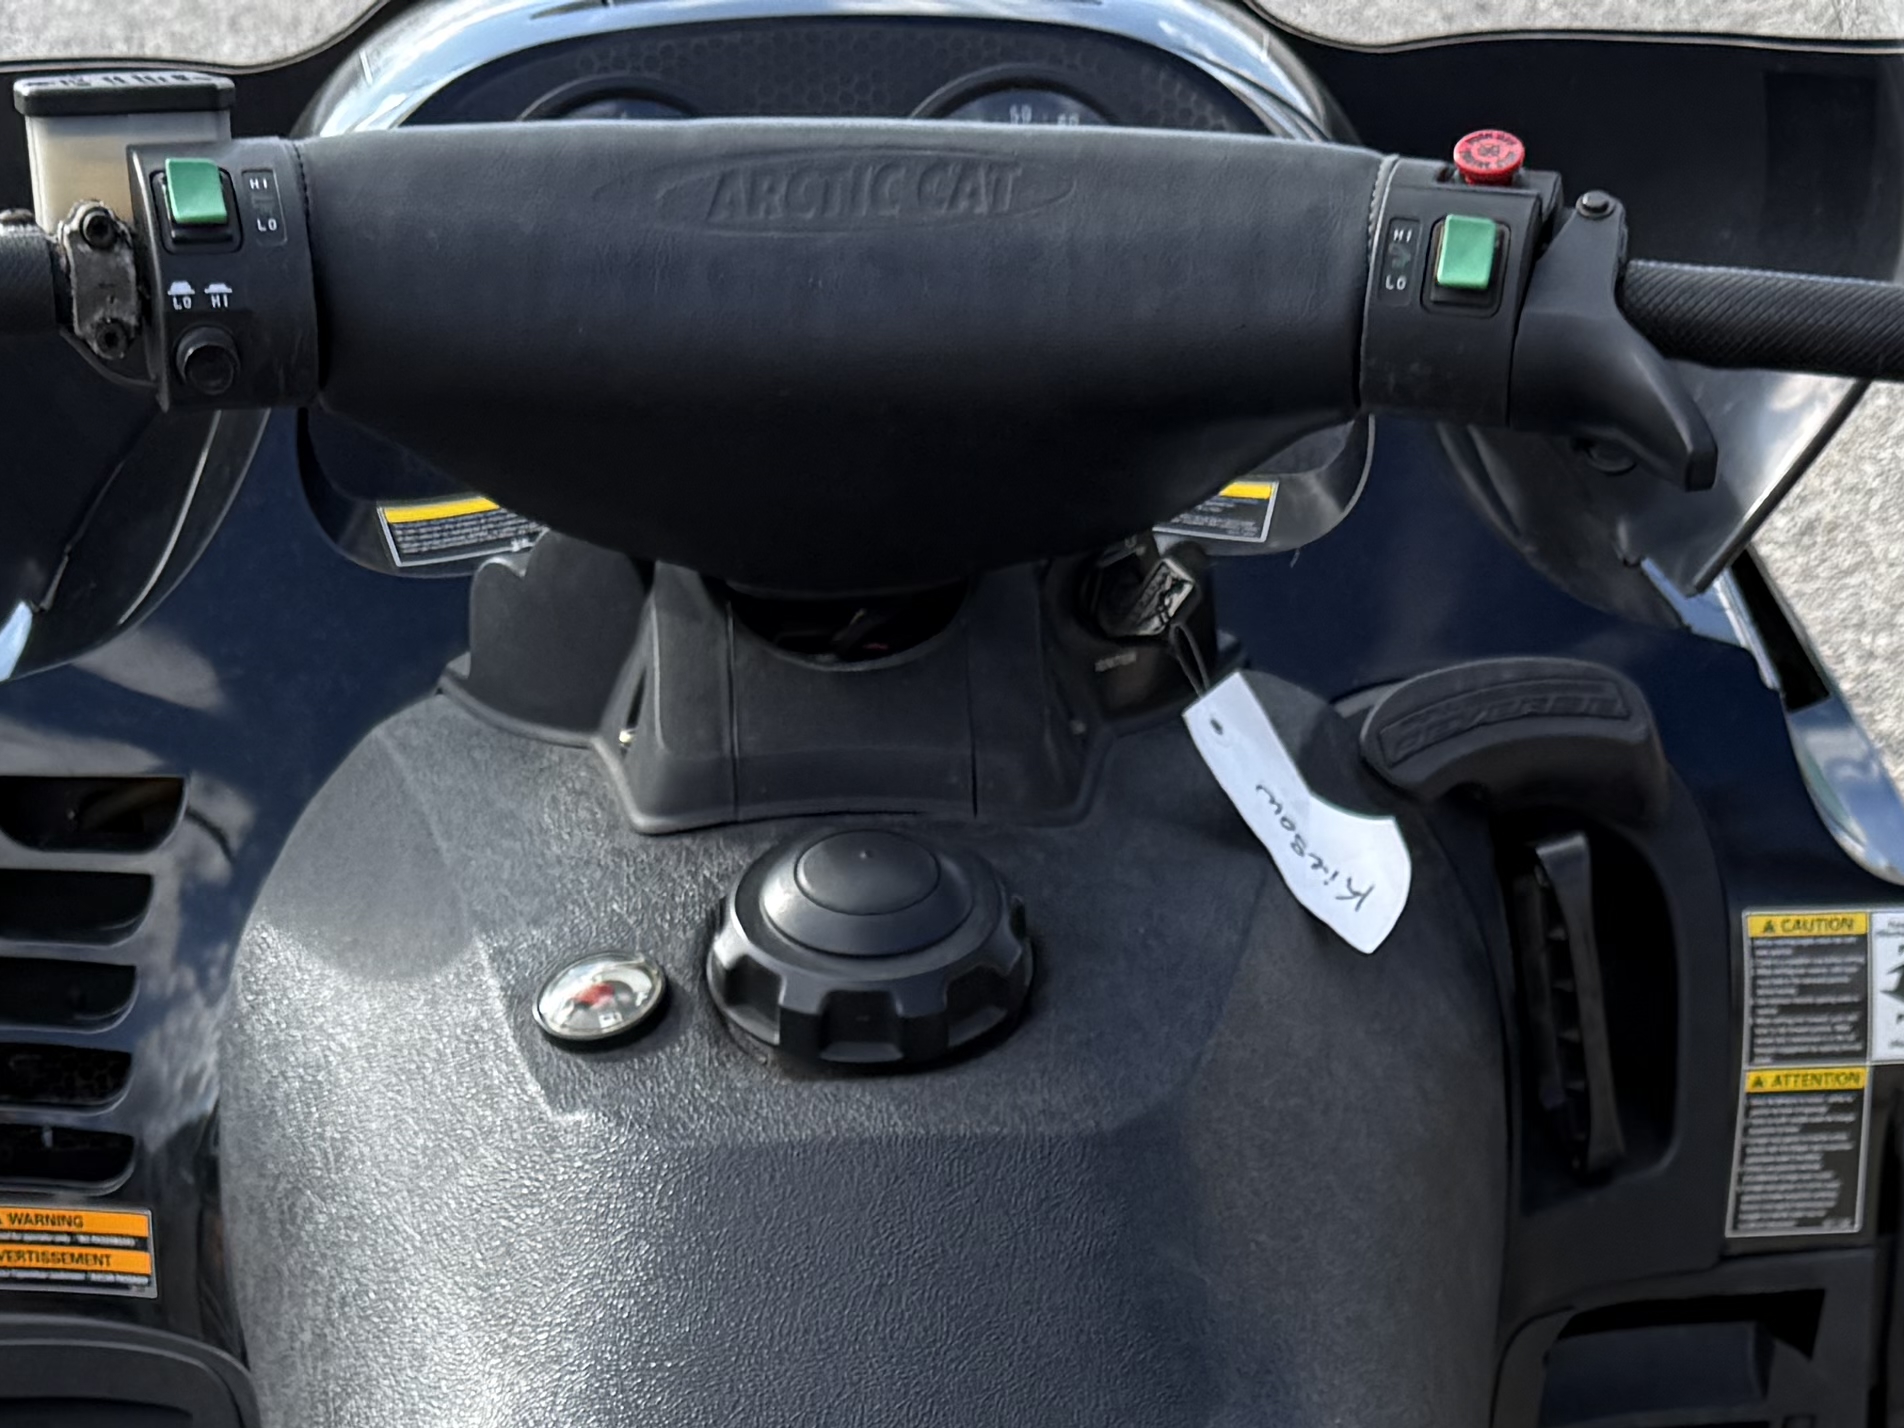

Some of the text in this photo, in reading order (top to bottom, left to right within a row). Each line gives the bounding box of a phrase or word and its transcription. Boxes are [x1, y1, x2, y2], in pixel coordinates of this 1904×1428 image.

[249, 178, 268, 190] HI
[706, 159, 1024, 221] ARCTIC CAT
[256, 217, 277, 232] LO
[1393, 229, 1412, 243] HI
[1385, 274, 1407, 290] LO
[172, 294, 229, 310] LO HI
[1780, 917, 1854, 933] CAUTION
[1771, 1071, 1861, 1088] ATTENTION
[7, 1212, 84, 1229] WARNING
